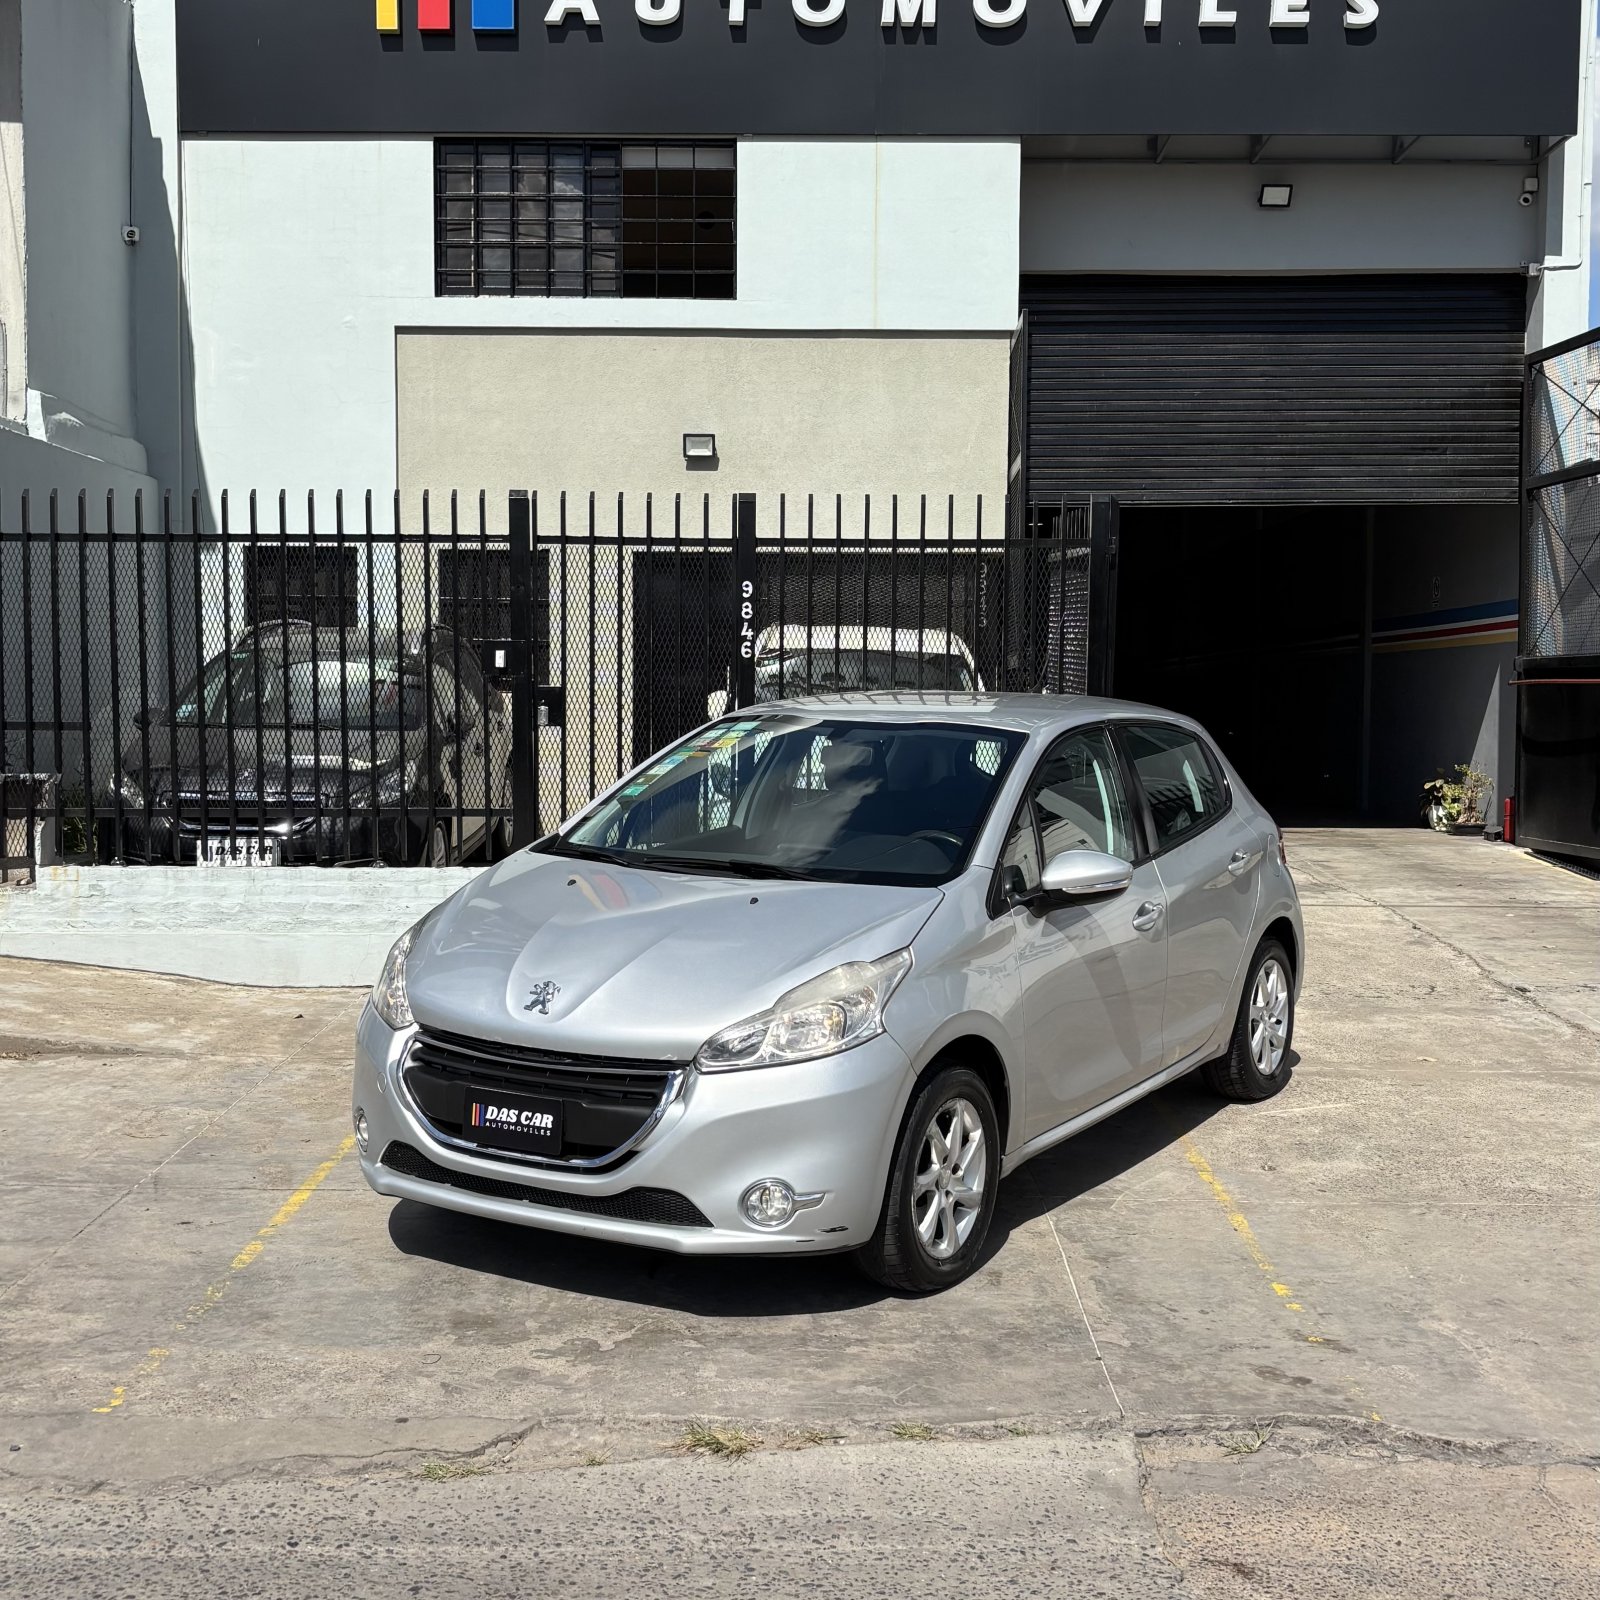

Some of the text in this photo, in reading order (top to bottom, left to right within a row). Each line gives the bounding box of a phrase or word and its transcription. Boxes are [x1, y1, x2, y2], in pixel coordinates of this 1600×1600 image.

[740, 580, 754, 658] 9846
[485, 1105, 554, 1129] DAS CAR
[485, 1121, 551, 1137] AUTOMOVILES
